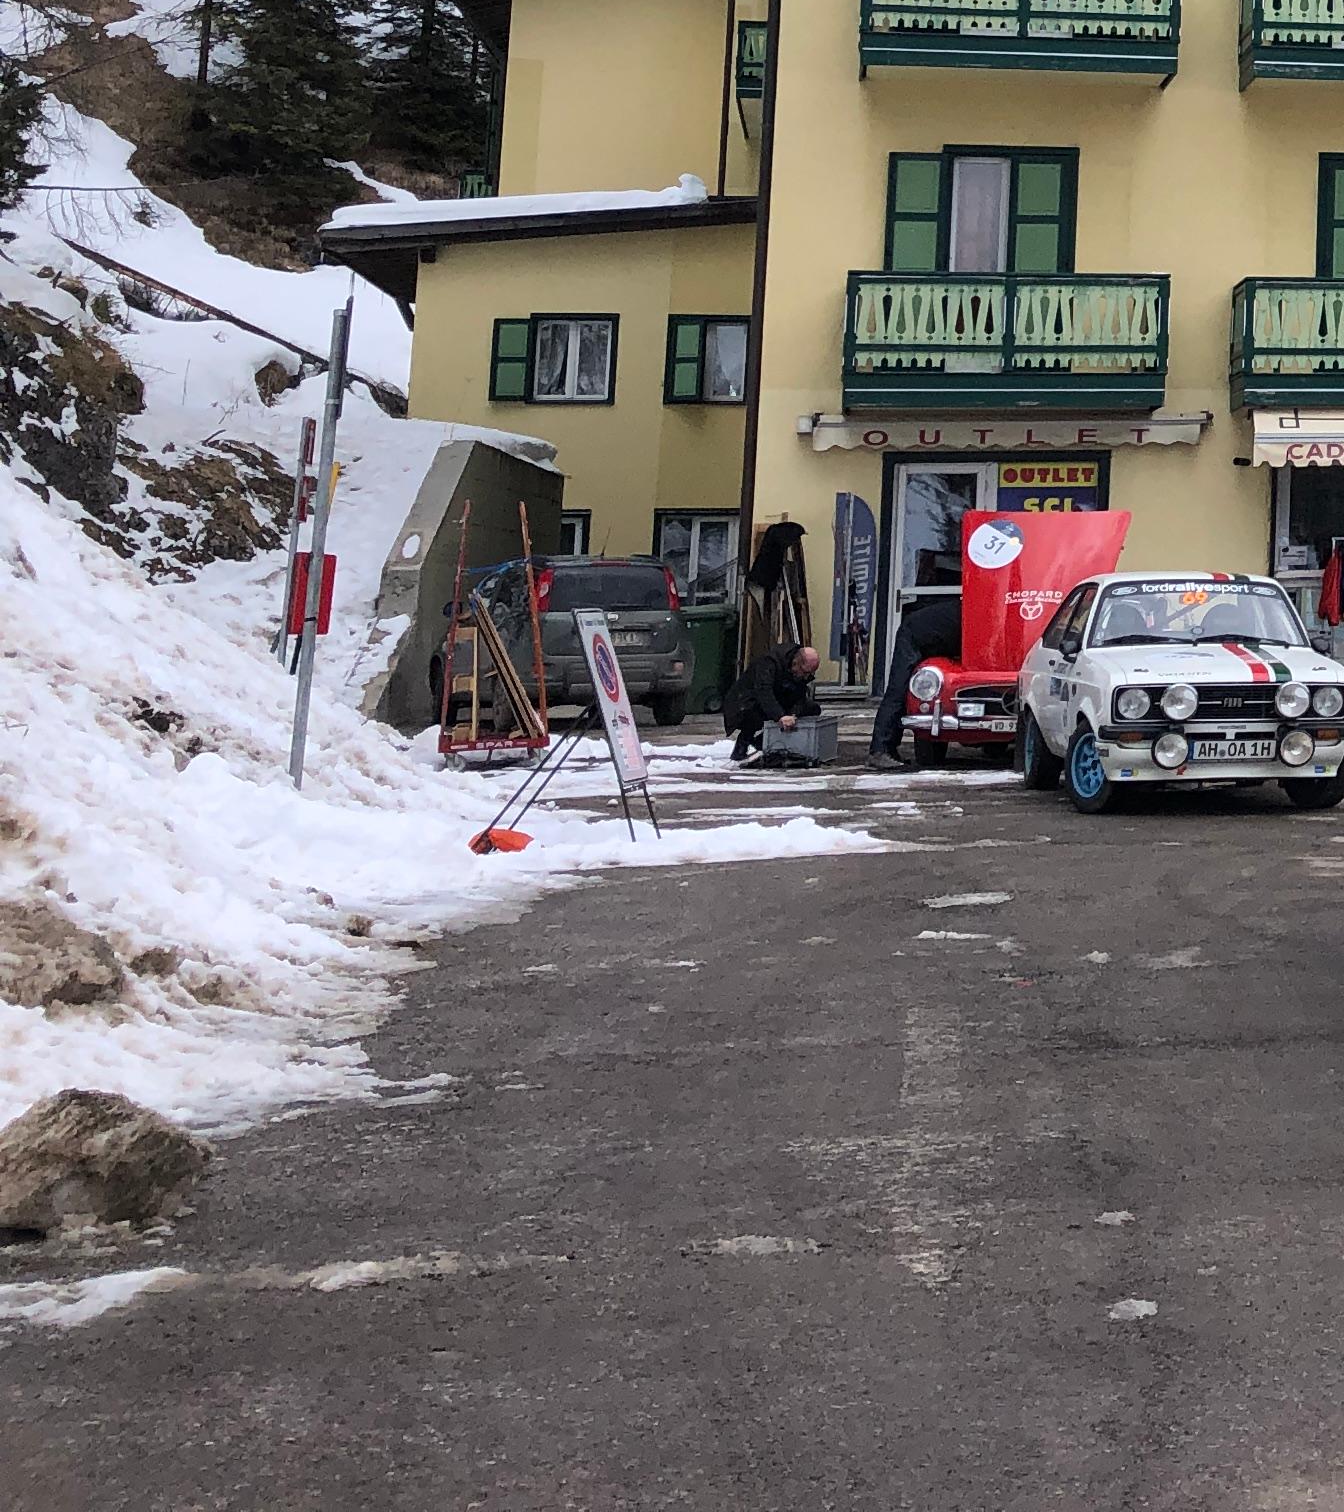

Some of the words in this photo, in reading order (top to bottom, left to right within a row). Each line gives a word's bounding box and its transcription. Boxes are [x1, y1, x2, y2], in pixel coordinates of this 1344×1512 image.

[861, 428, 1151, 446] OUTLET
[1002, 467, 1095, 484] OUTLET
[983, 535, 1007, 555] 31
[1005, 590, 1063, 599] CHOPARD
[1182, 591, 1208, 605] 69
[1197, 742, 1219, 758] AH
[1226, 741, 1247, 757] OA
[1250, 741, 1272, 757] 1H
